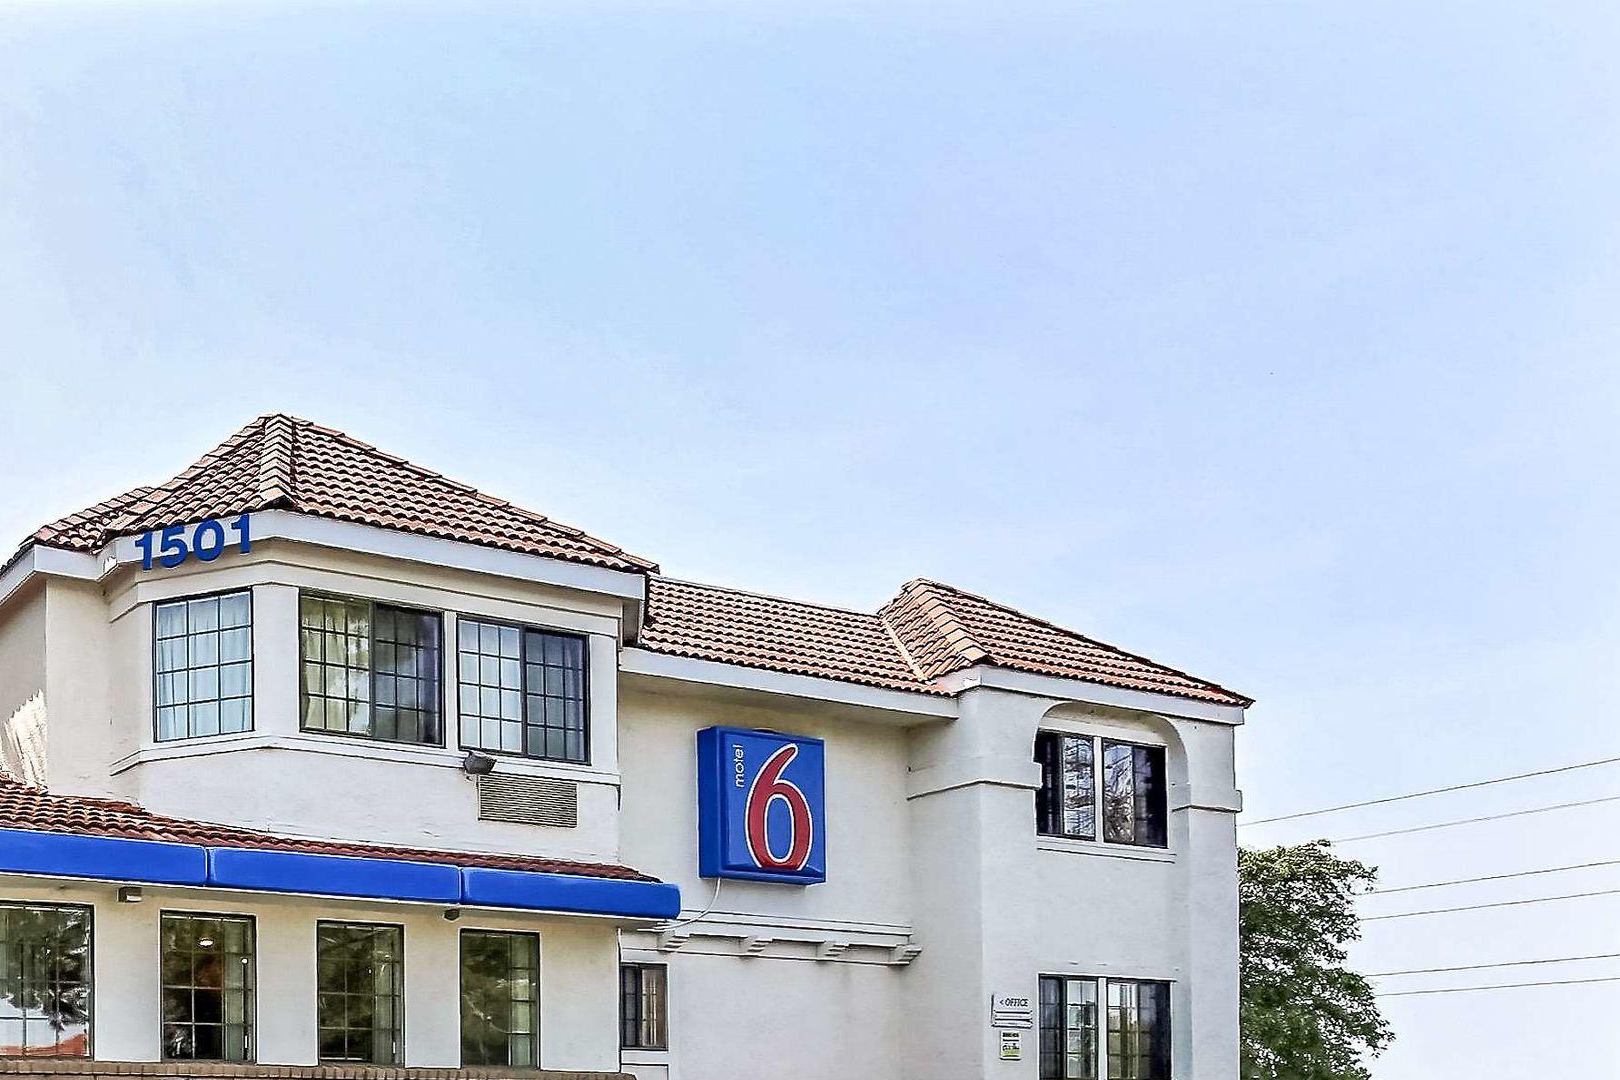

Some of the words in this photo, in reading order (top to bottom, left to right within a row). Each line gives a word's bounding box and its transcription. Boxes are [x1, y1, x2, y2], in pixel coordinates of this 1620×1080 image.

[134, 513, 251, 570] 1501
[732, 744, 745, 788] motel
[744, 742, 814, 871] 6
[1004, 997, 1029, 1007] OFFICE
